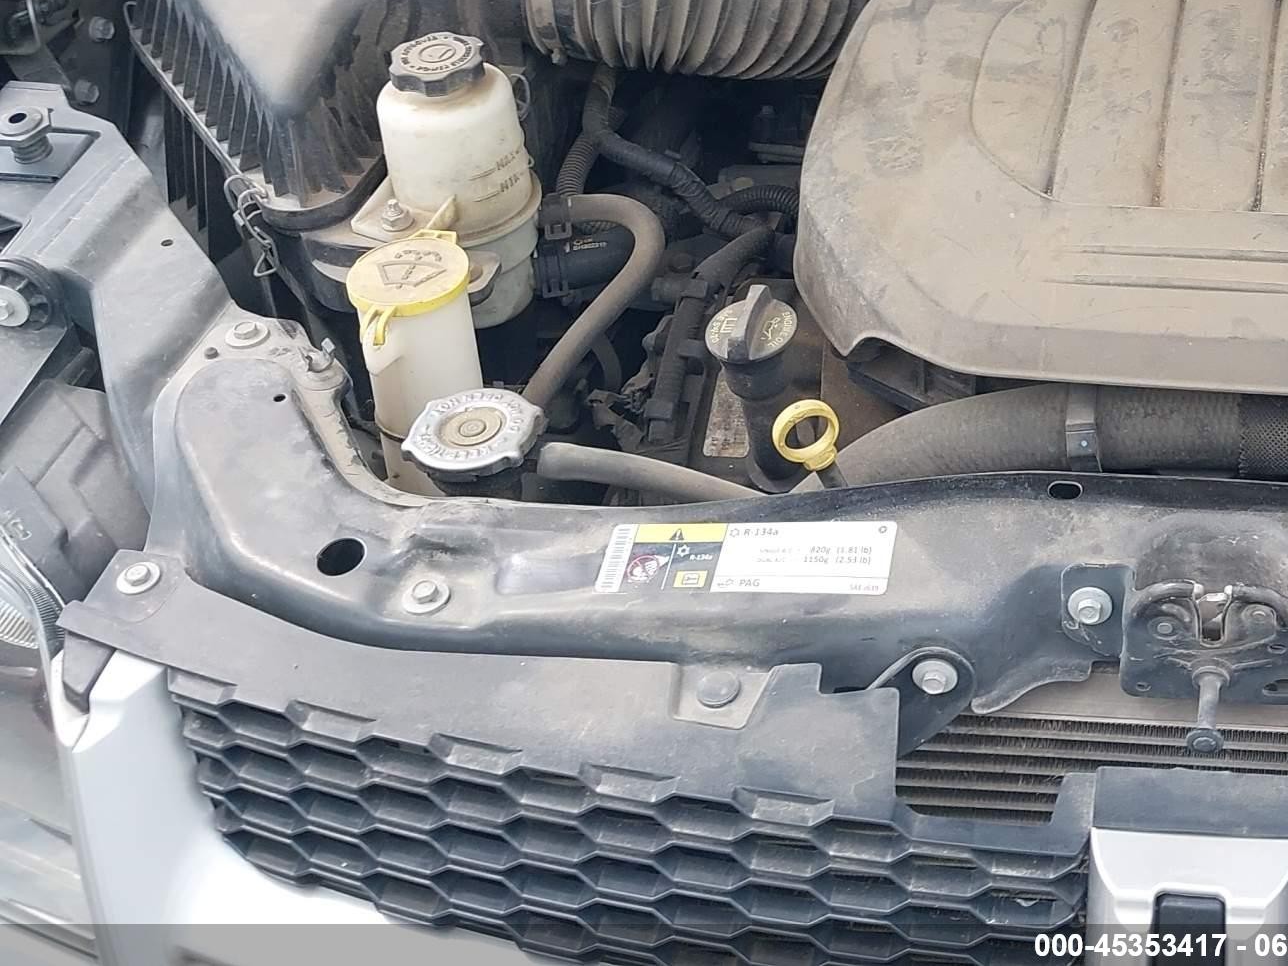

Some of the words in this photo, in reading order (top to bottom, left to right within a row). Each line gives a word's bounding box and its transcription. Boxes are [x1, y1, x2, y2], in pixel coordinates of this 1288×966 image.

[781, 311, 794, 338] ENGINE
[767, 335, 785, 348] OIL
[742, 527, 780, 537] R-134a
[802, 555, 829, 565] 1150g
[738, 578, 761, 588] PAG
